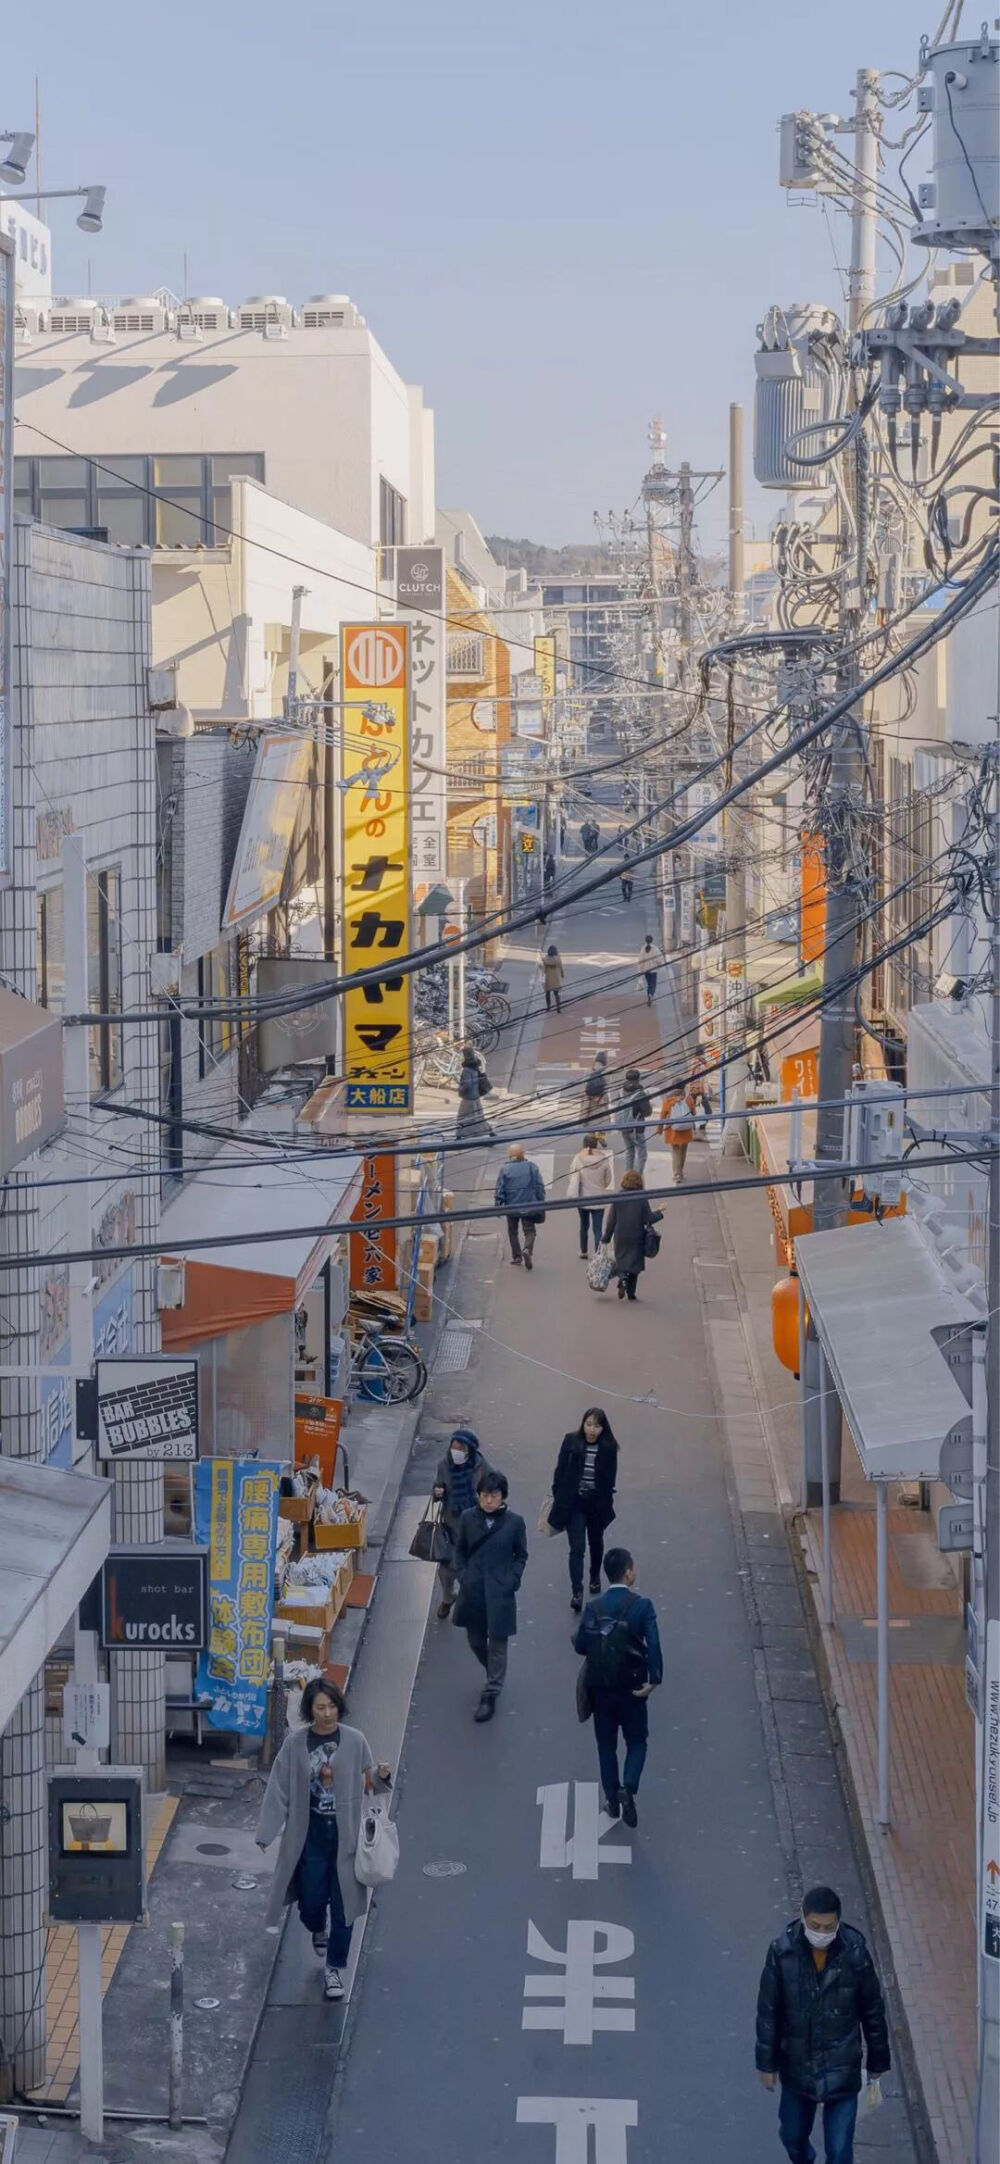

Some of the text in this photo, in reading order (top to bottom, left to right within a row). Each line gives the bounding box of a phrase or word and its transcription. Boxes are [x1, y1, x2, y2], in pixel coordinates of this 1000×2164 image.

[399, 583, 441, 593] CLUTCH
[412, 619, 436, 822] ネットカフェ
[350, 1087, 406, 1105] 大船店
[102, 1401, 136, 1424] BAR
[108, 1408, 192, 1447] BUBBLES
[146, 1443, 194, 1458] by 213
[140, 1584, 195, 1593] shot bar
[109, 1576, 196, 1640] kurocks
